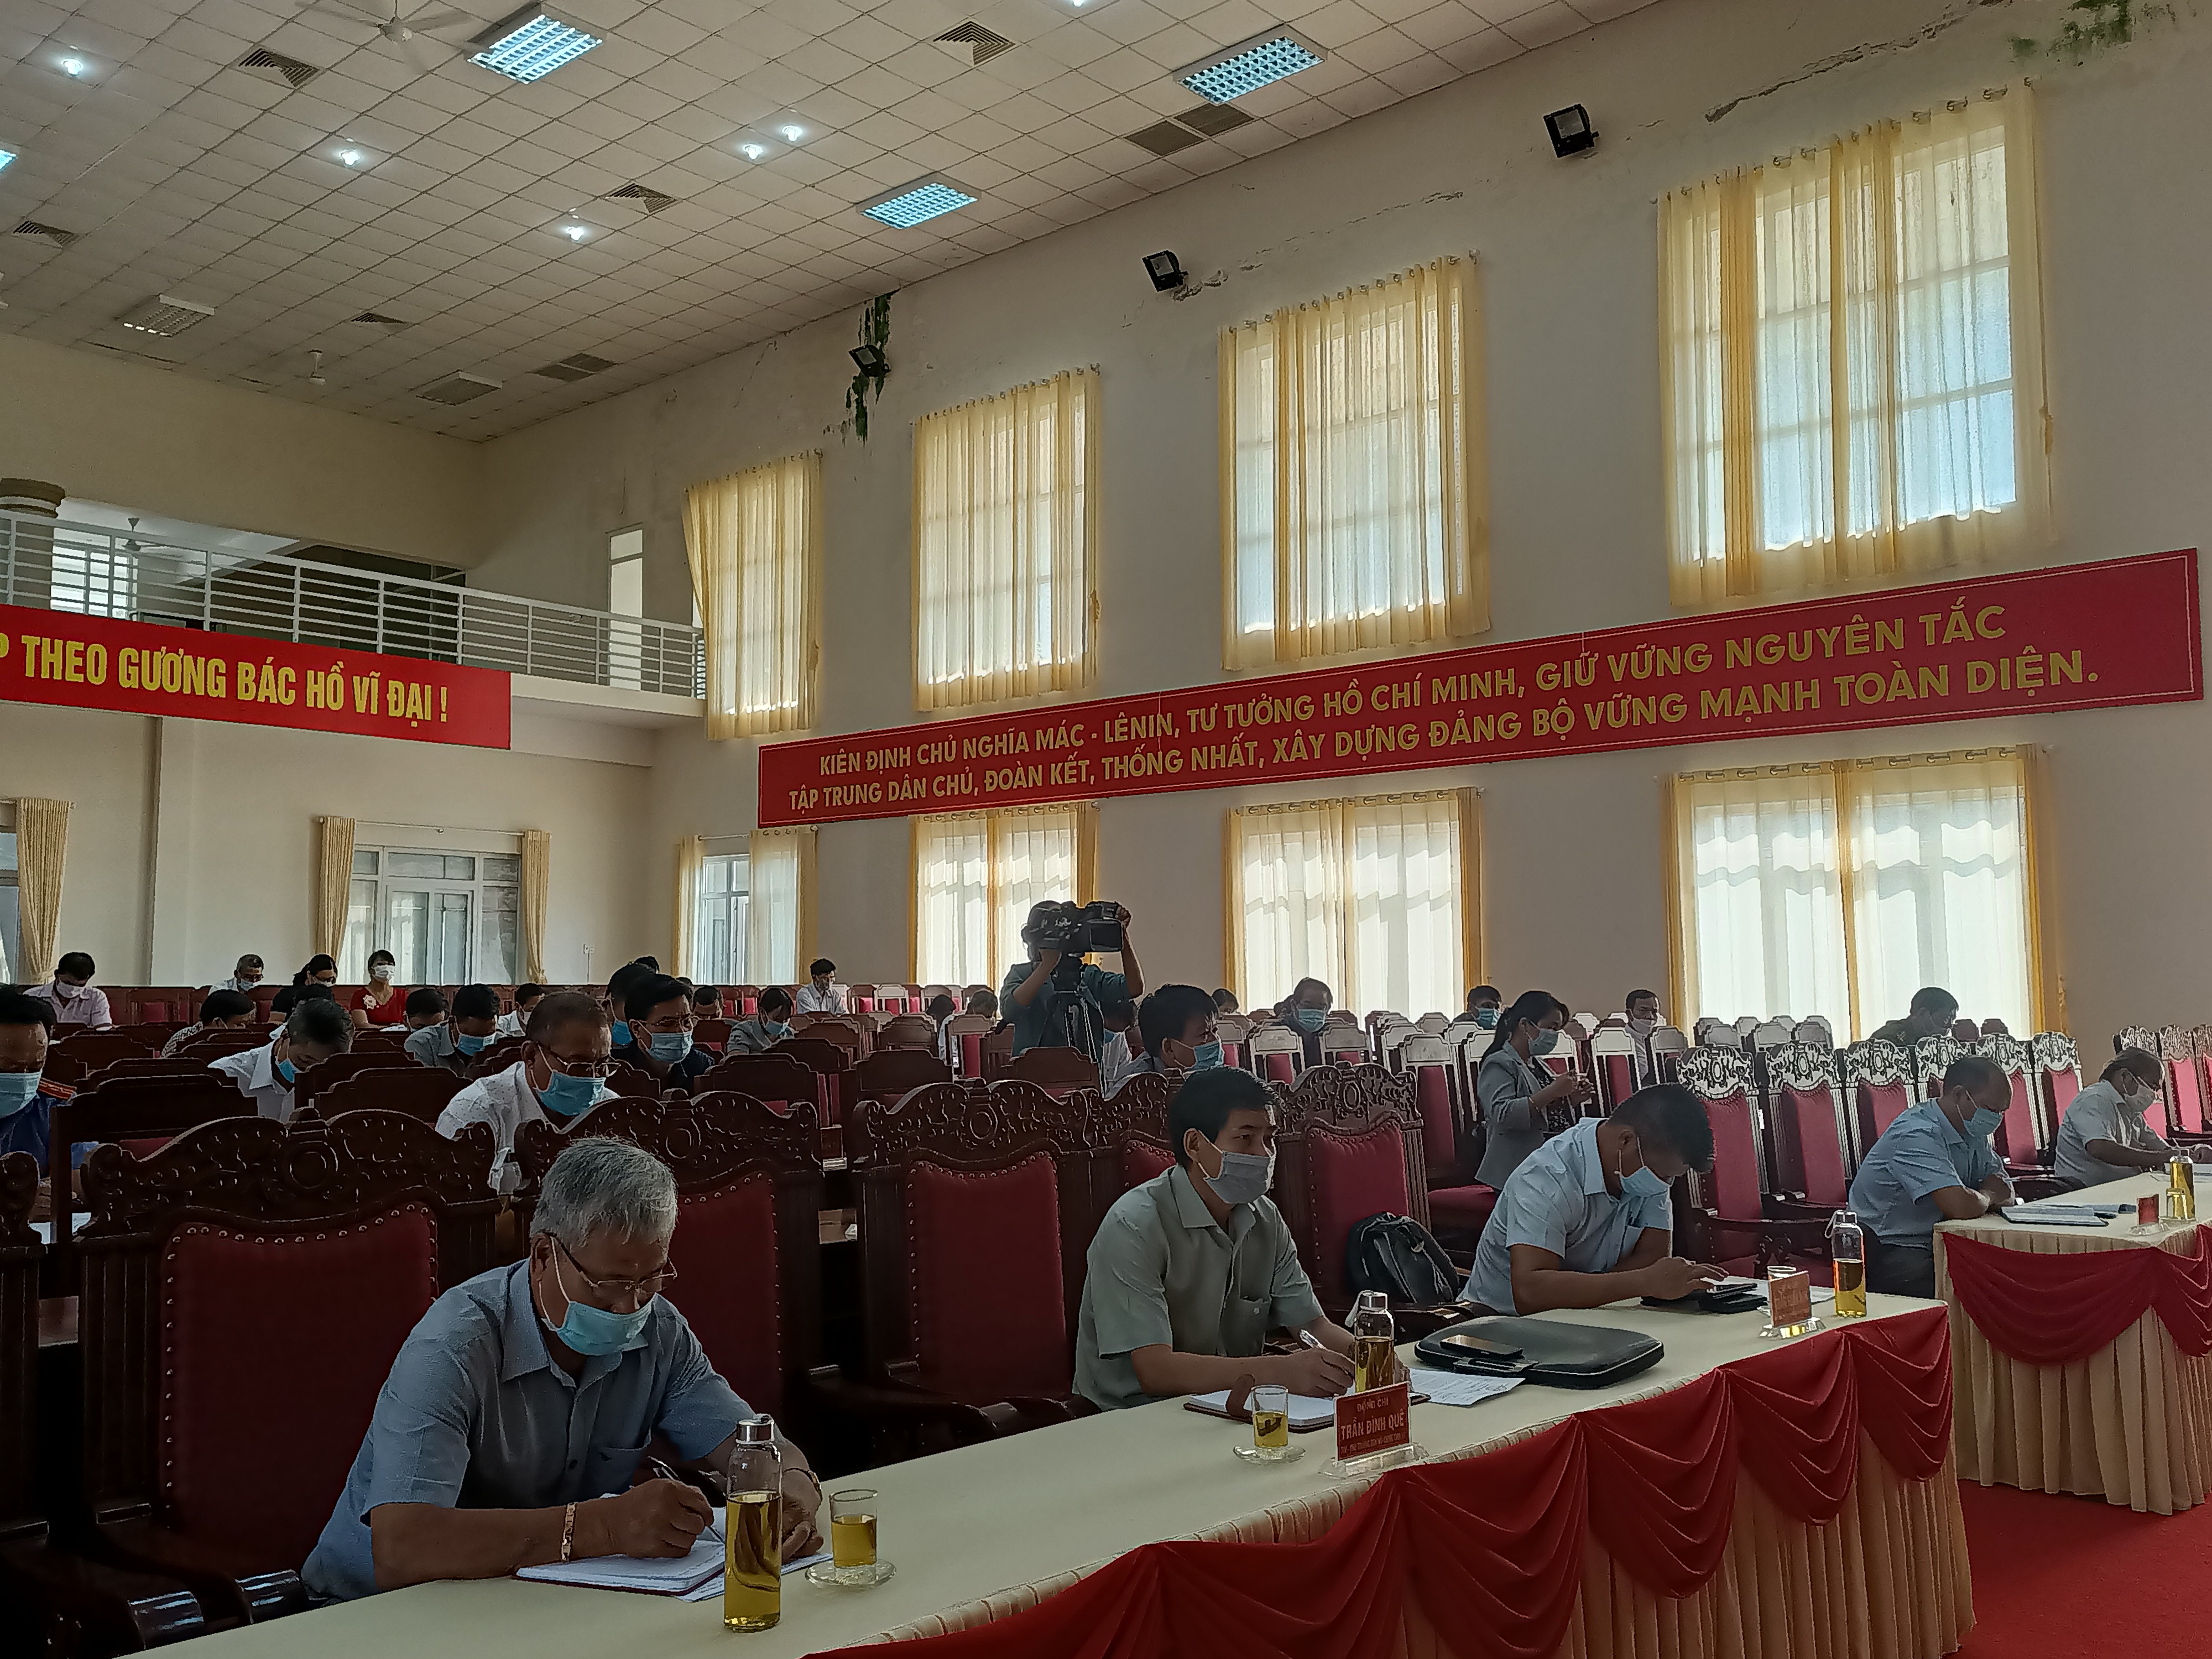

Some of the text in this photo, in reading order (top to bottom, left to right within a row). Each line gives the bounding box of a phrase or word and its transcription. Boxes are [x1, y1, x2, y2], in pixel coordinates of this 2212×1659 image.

[21, 634, 107, 685] THEO
[118, 646, 226, 698] GƯƠNG
[237, 656, 296, 706] BÁC
[306, 661, 344, 711] HỒ
[353, 671, 381, 714] VĨ
[386, 680, 432, 728] ĐẠI
[440, 686, 447, 723] !
[789, 645, 2098, 813] TẬP TRUNG DÂN CHỦ, ĐOÀN KẾT, THỐNG NHẤT, XÂY DỰNG ĐẢNG BỘ VỮNG MẠNH TOÀN DIỆN.
[820, 748, 860, 775] KIÊN
[865, 747, 910, 777] ĐỊNH
[916, 733, 956, 765] CHỦ
[963, 728, 1029, 759] NGHĨA
[1036, 719, 1083, 750] MÁC
[1105, 712, 1180, 743] LÊNIN,
[1187, 703, 1218, 732] TƯ
[1223, 693, 1314, 728] TƯỞNG
[1324, 679, 1363, 717] HỒ
[1371, 672, 1420, 711] CHÍ
[1432, 668, 1525, 705] MINH,
[1536, 653, 1597, 691] GIỮ
[1607, 643, 1713, 682] VỮNG
[1725, 614, 1904, 669] NGUYÊN
[1918, 597, 2005, 645] TẮC
